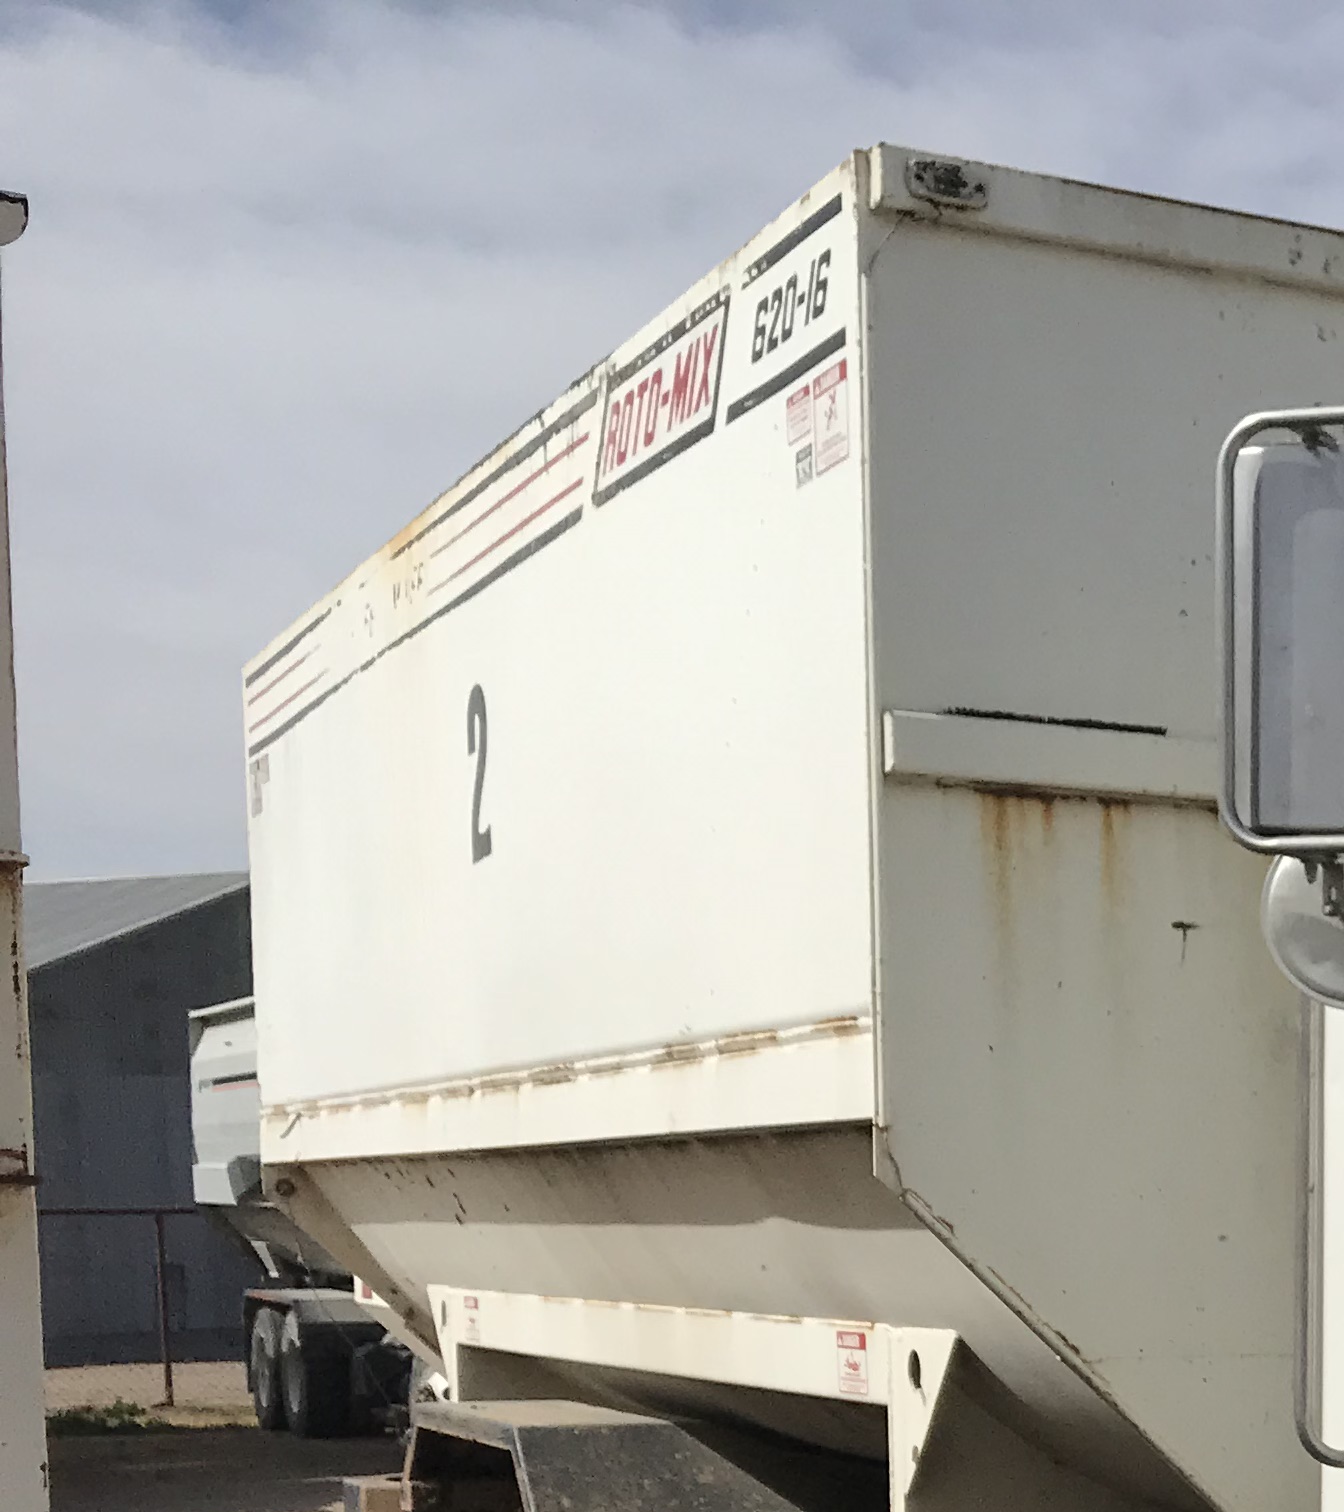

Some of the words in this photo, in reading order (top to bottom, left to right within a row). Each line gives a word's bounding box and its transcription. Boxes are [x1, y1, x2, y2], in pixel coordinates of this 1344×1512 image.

[751, 248, 831, 364] 620-16
[602, 322, 719, 477] ROTO-MIX
[467, 684, 491, 865] 2
